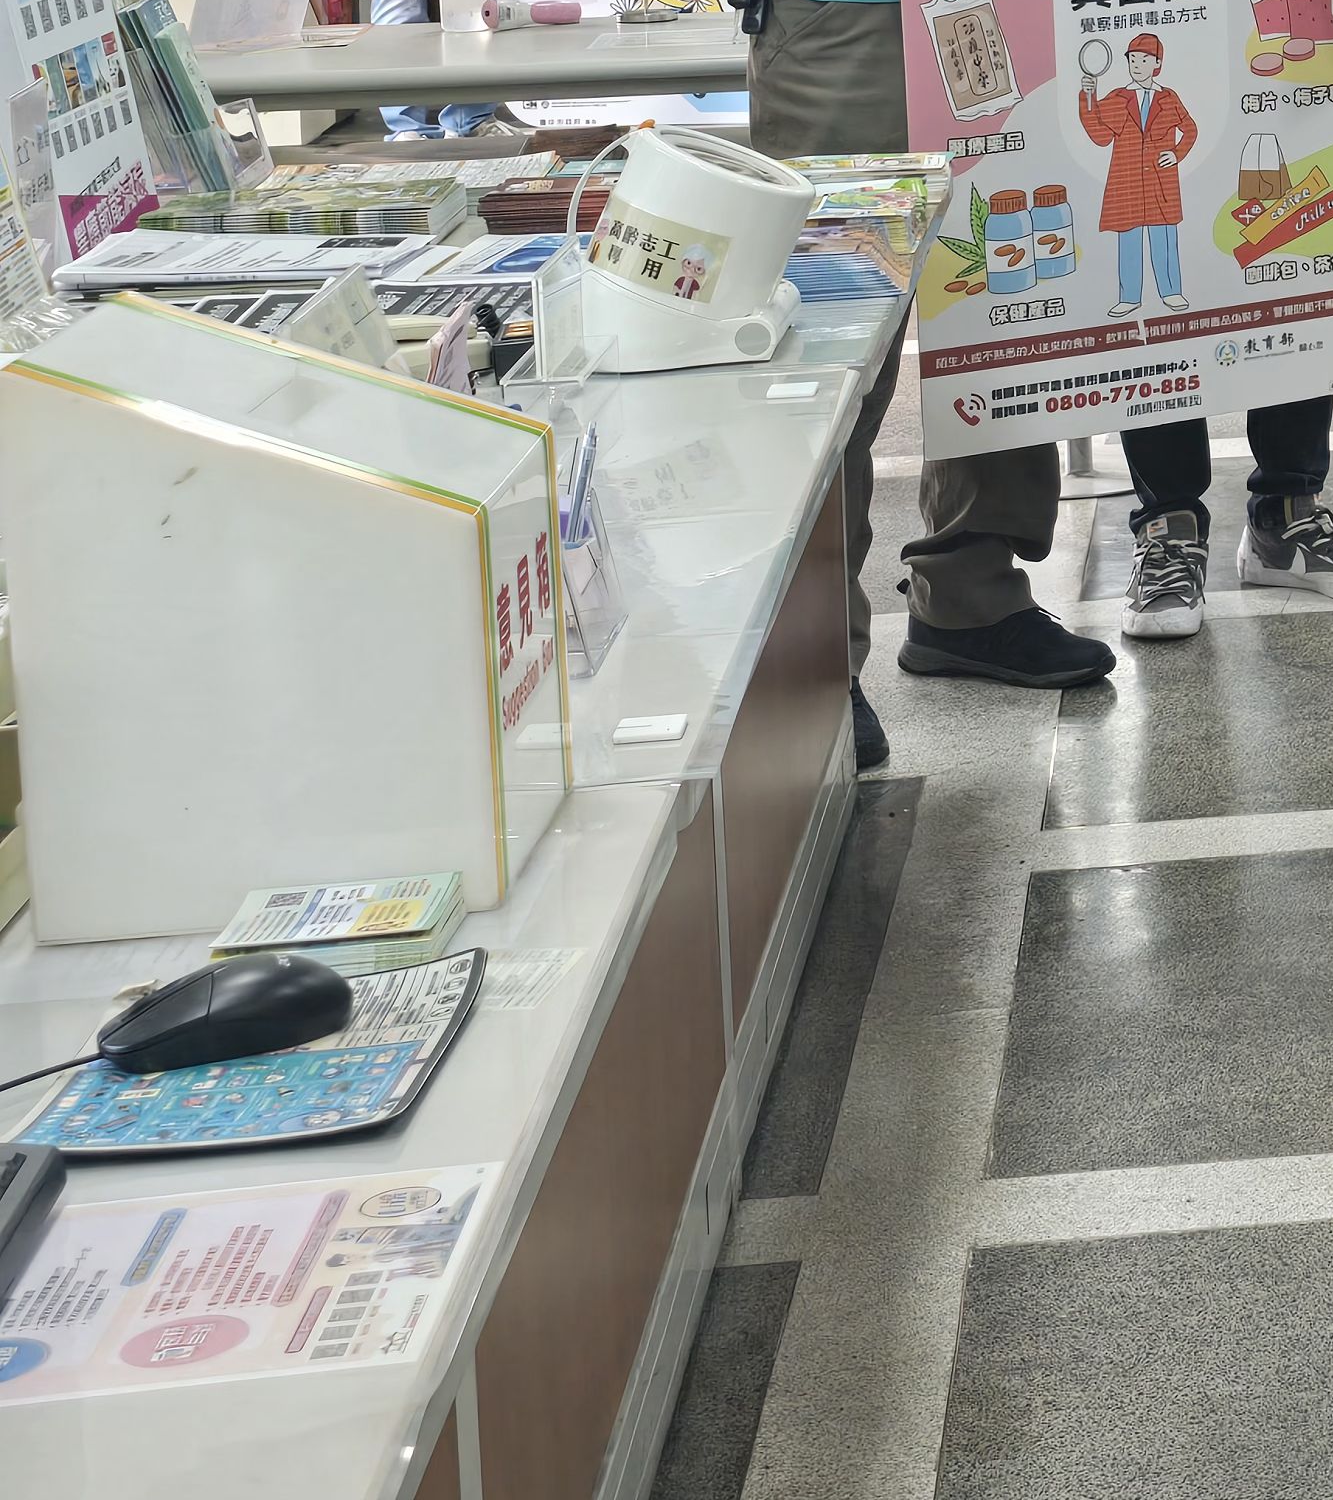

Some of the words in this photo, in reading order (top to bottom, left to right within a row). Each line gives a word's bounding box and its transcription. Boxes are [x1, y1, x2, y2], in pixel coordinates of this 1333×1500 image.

[989, 298, 1066, 326] 保健產品
[1045, 374, 1200, 414] 0800-770-885
